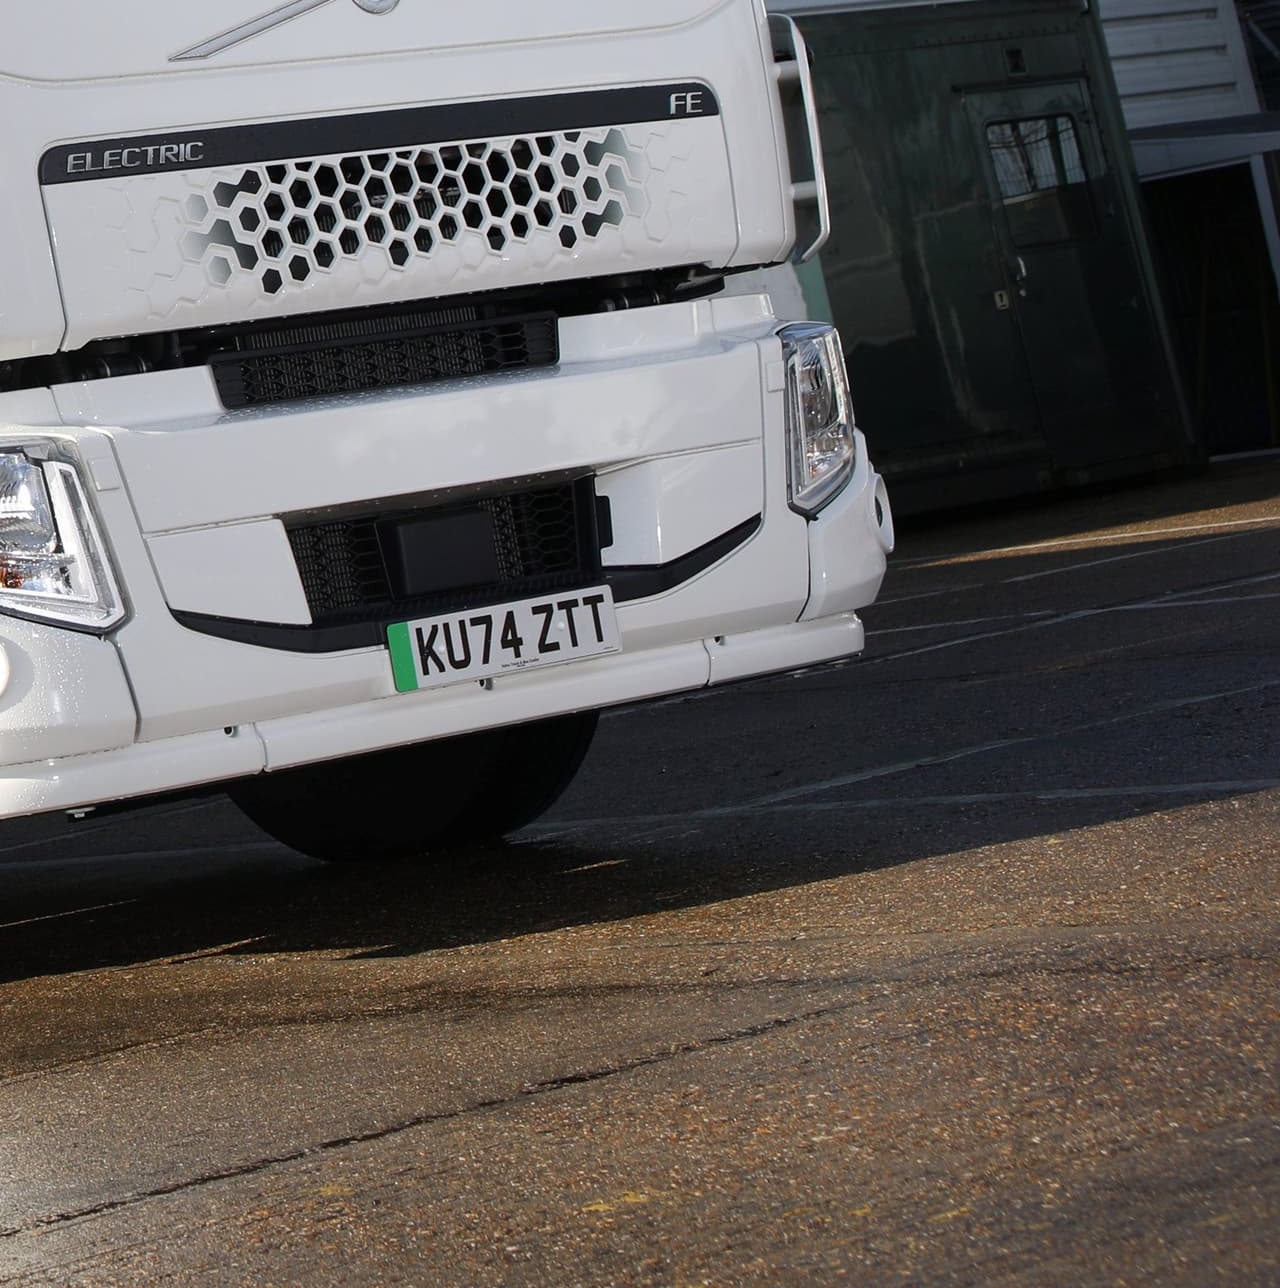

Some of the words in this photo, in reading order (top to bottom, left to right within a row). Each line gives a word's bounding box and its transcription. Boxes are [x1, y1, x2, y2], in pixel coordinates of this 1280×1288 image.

[669, 91, 703, 115] FE
[65, 140, 205, 174] ELECTRIC
[415, 610, 524, 676] KU74
[531, 593, 605, 654] ZTT
